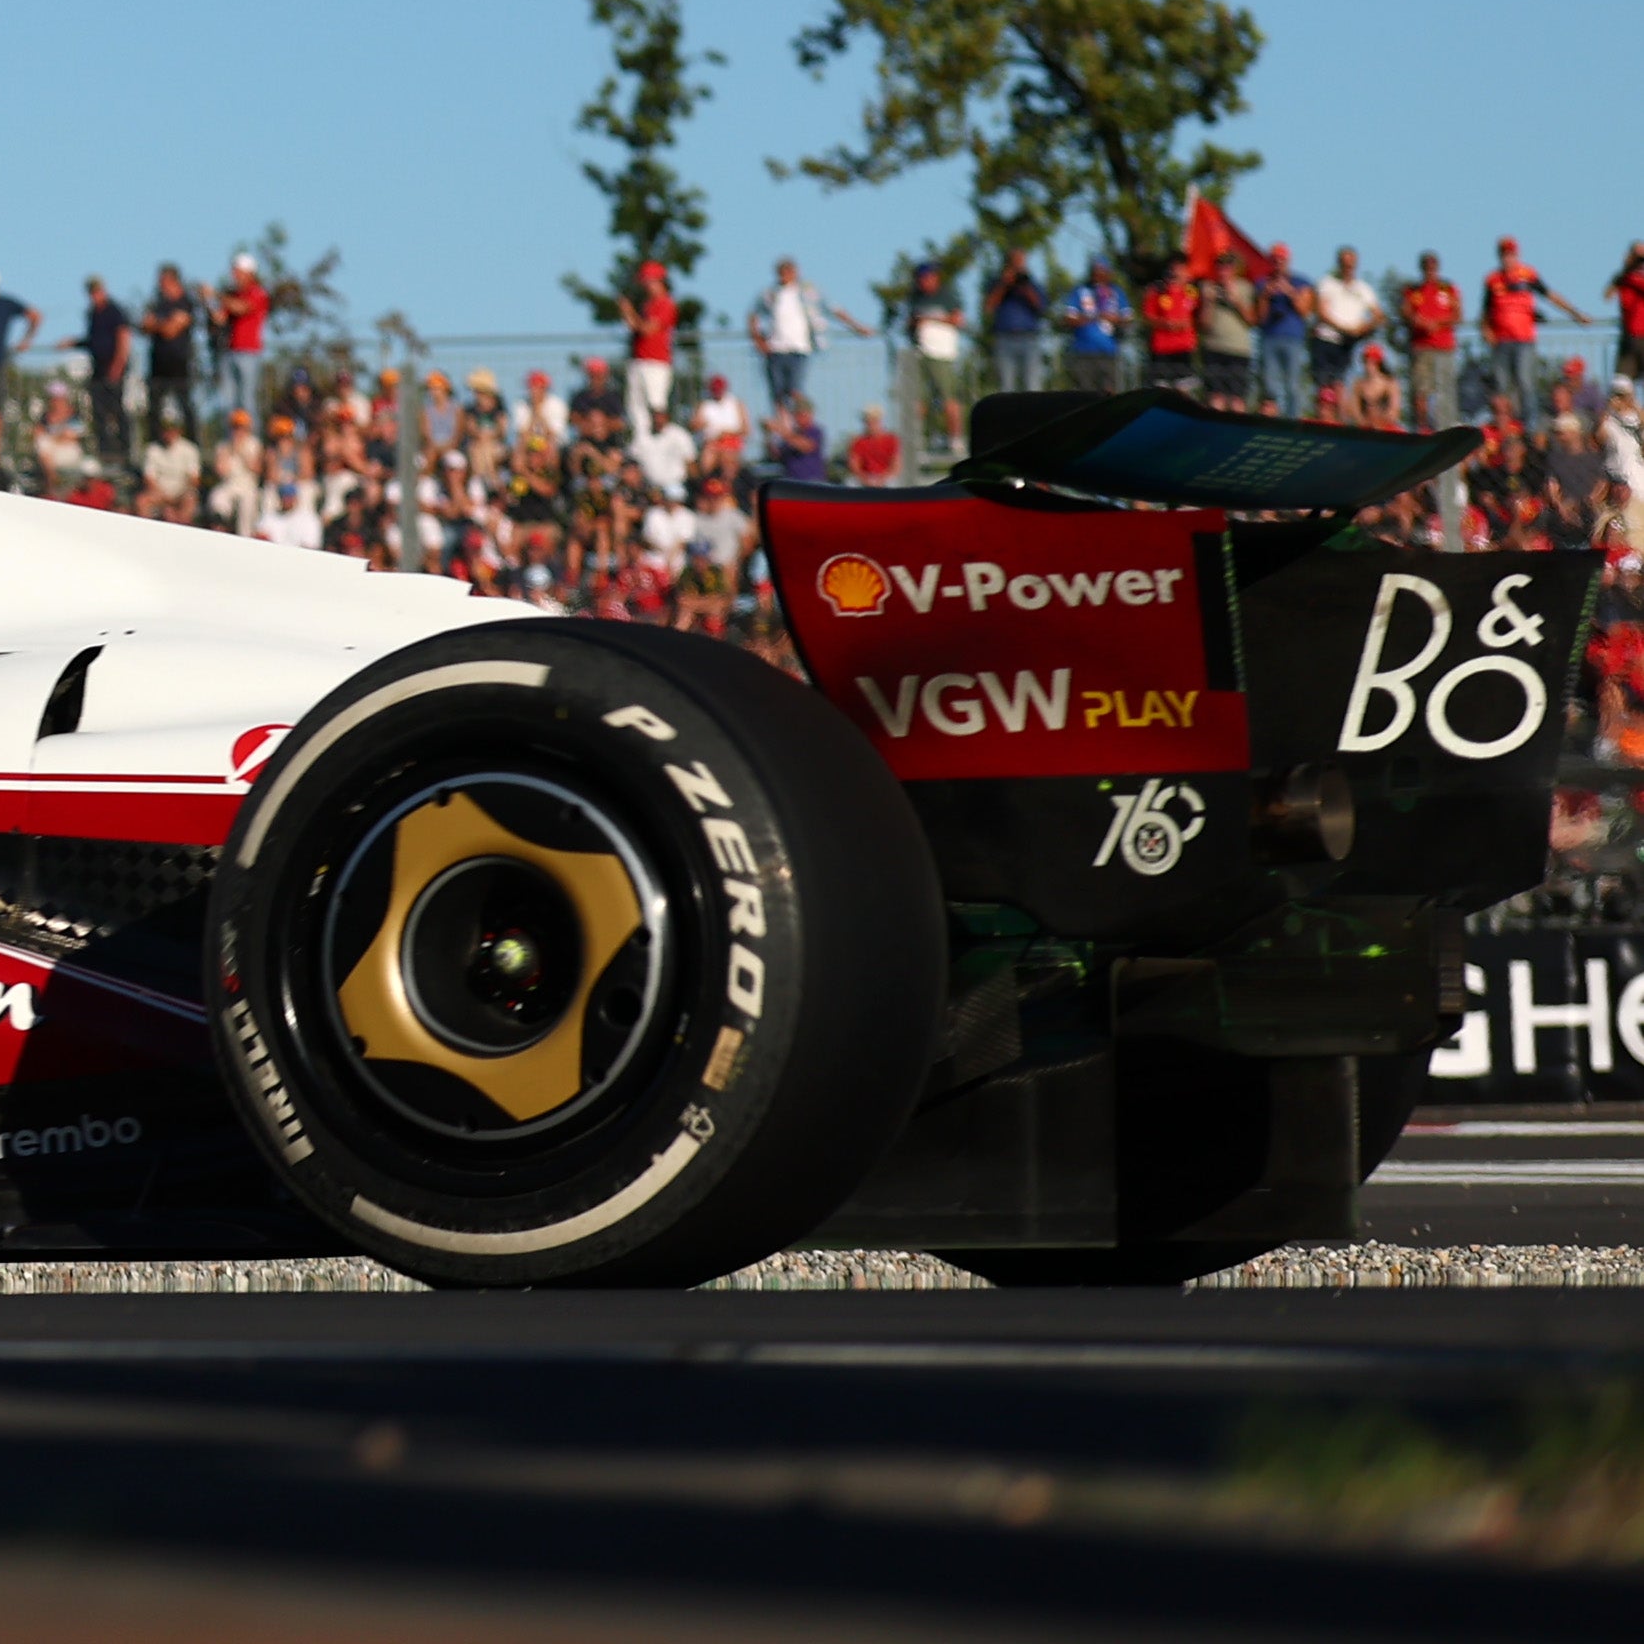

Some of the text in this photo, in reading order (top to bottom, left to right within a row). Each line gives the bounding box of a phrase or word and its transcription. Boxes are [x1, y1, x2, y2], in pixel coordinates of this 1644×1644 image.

[889, 562, 1184, 614] V-Power
[855, 668, 1200, 738] VGW PLAY
[601, 704, 679, 741] P
[663, 761, 768, 1019] ZERO
